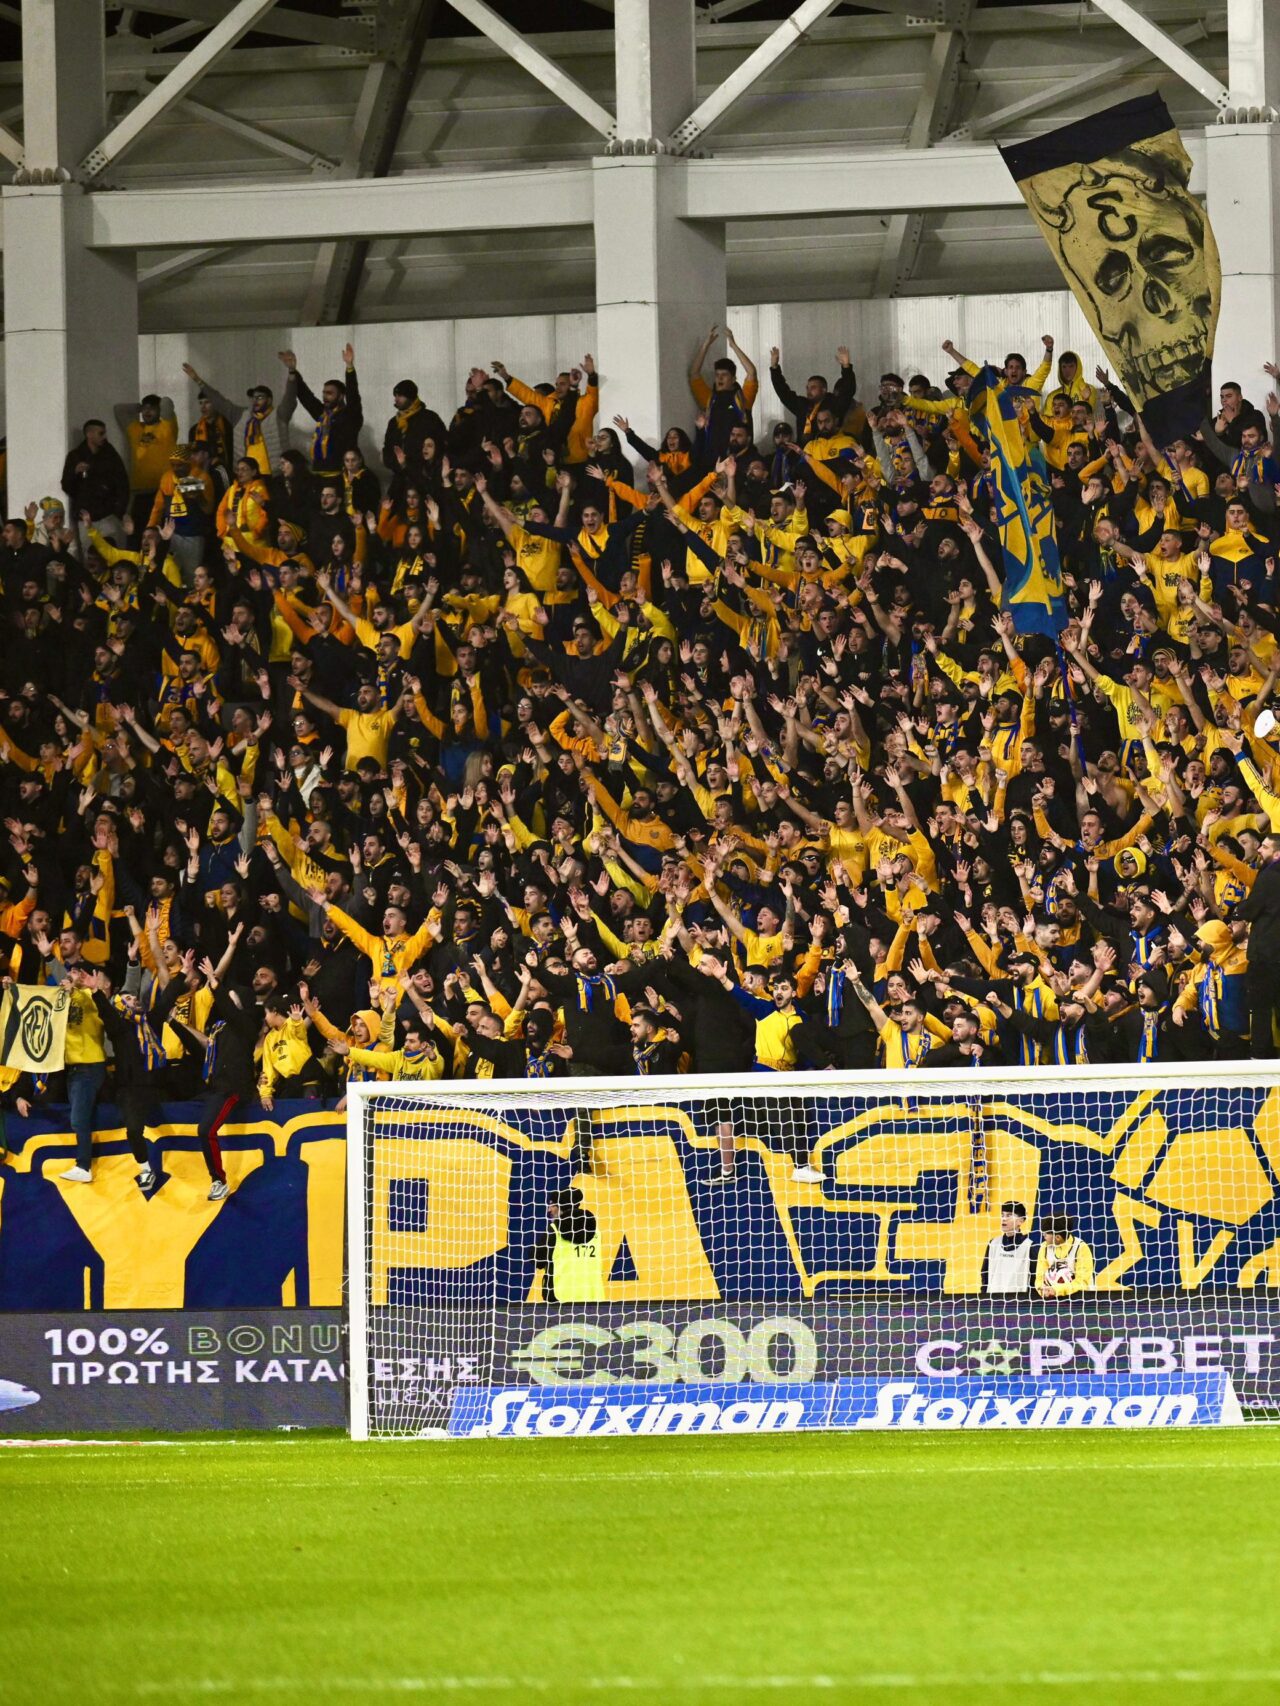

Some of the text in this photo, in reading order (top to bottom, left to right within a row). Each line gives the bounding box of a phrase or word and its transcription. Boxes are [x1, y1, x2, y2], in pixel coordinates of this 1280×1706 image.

[0, 1130, 722, 1308] ΥΡΑ
[575, 1245, 596, 1258] 172
[44, 1325, 348, 1355] 100% BONU
[512, 1316, 818, 1386] €300
[51, 1357, 480, 1385] ΠΡΩΤΗΣ ΚΑΤΑΕΣΗΣ
[474, 1390, 807, 1436] Stoiximan
[860, 1382, 1200, 1428] Stoiximan
